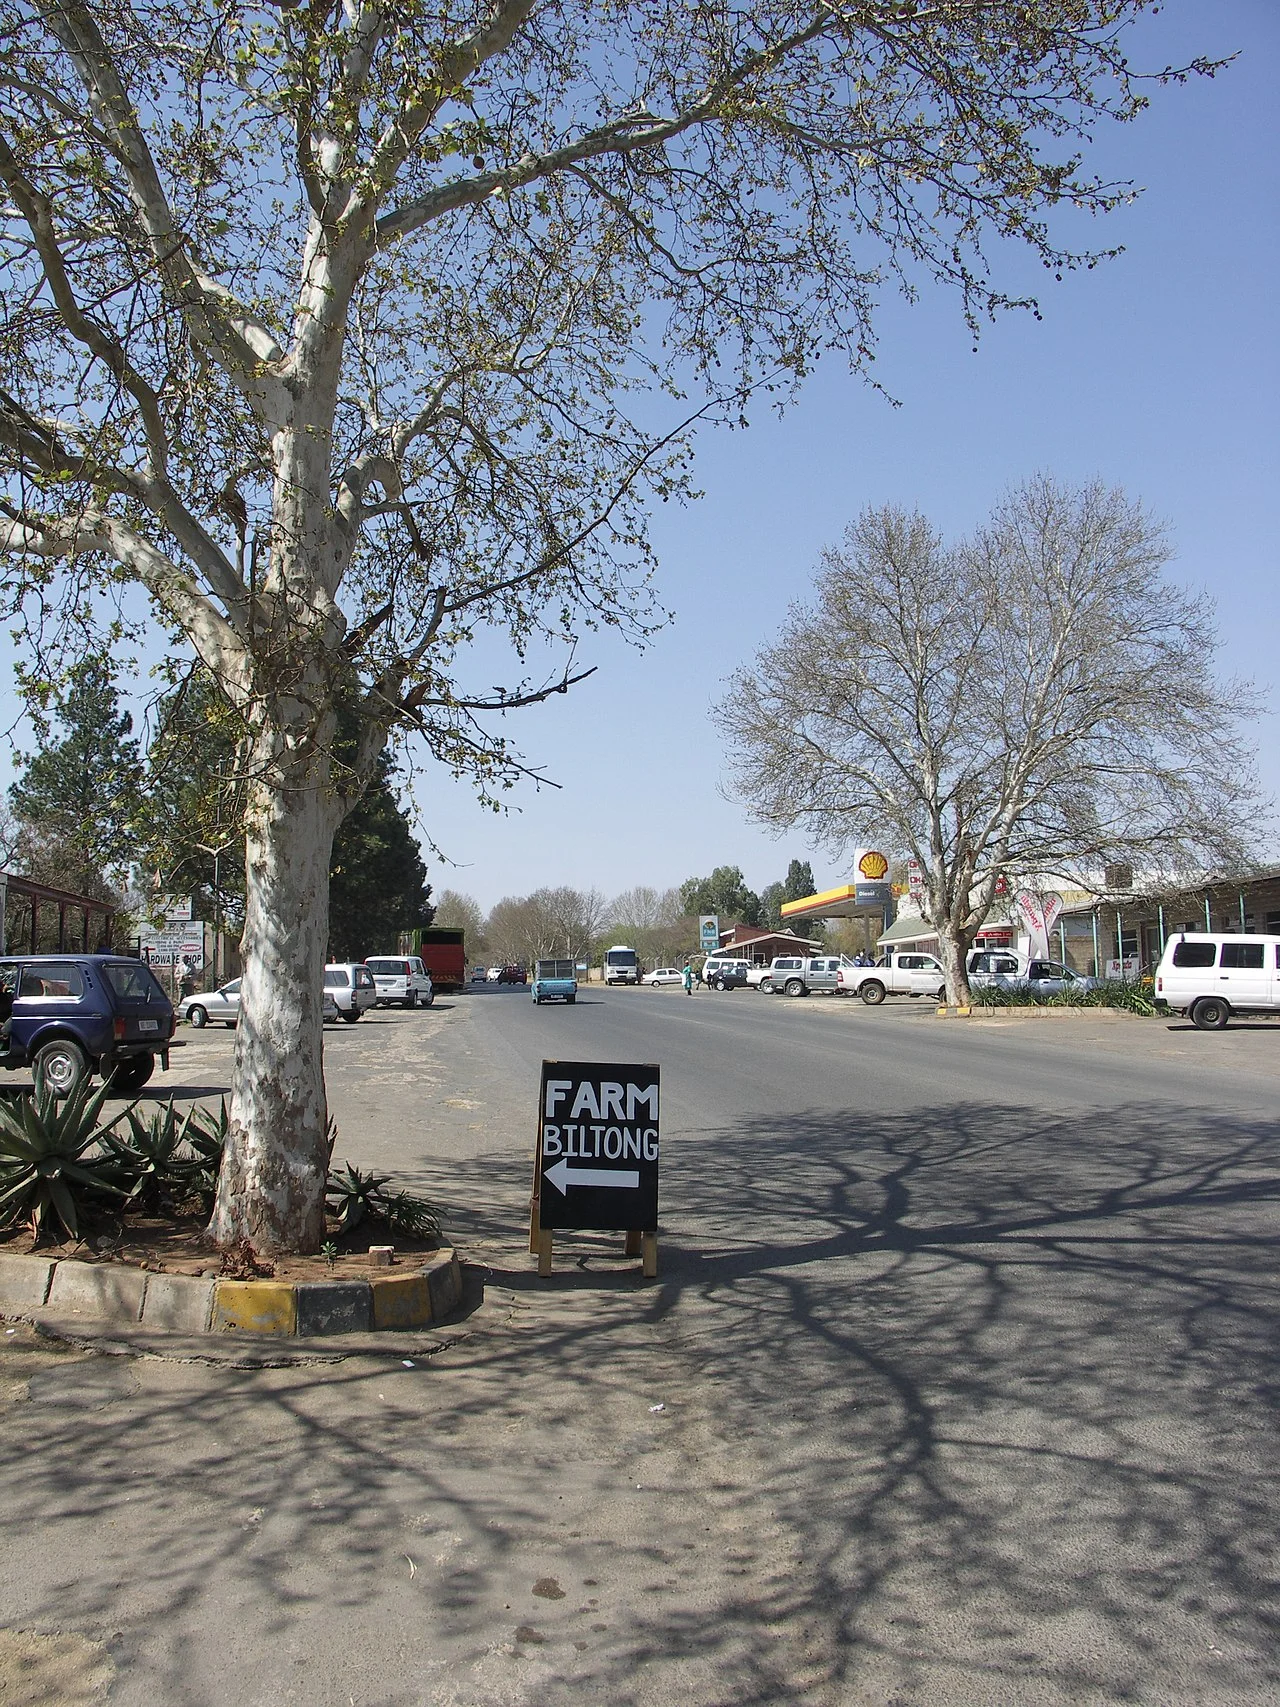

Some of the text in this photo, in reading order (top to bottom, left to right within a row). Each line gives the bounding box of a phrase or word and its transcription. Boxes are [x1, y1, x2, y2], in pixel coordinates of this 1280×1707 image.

[141, 954, 202, 964] HRDWAE HOP
[545, 1080, 659, 1121] FARM
[543, 1124, 659, 1161] BILTONG
